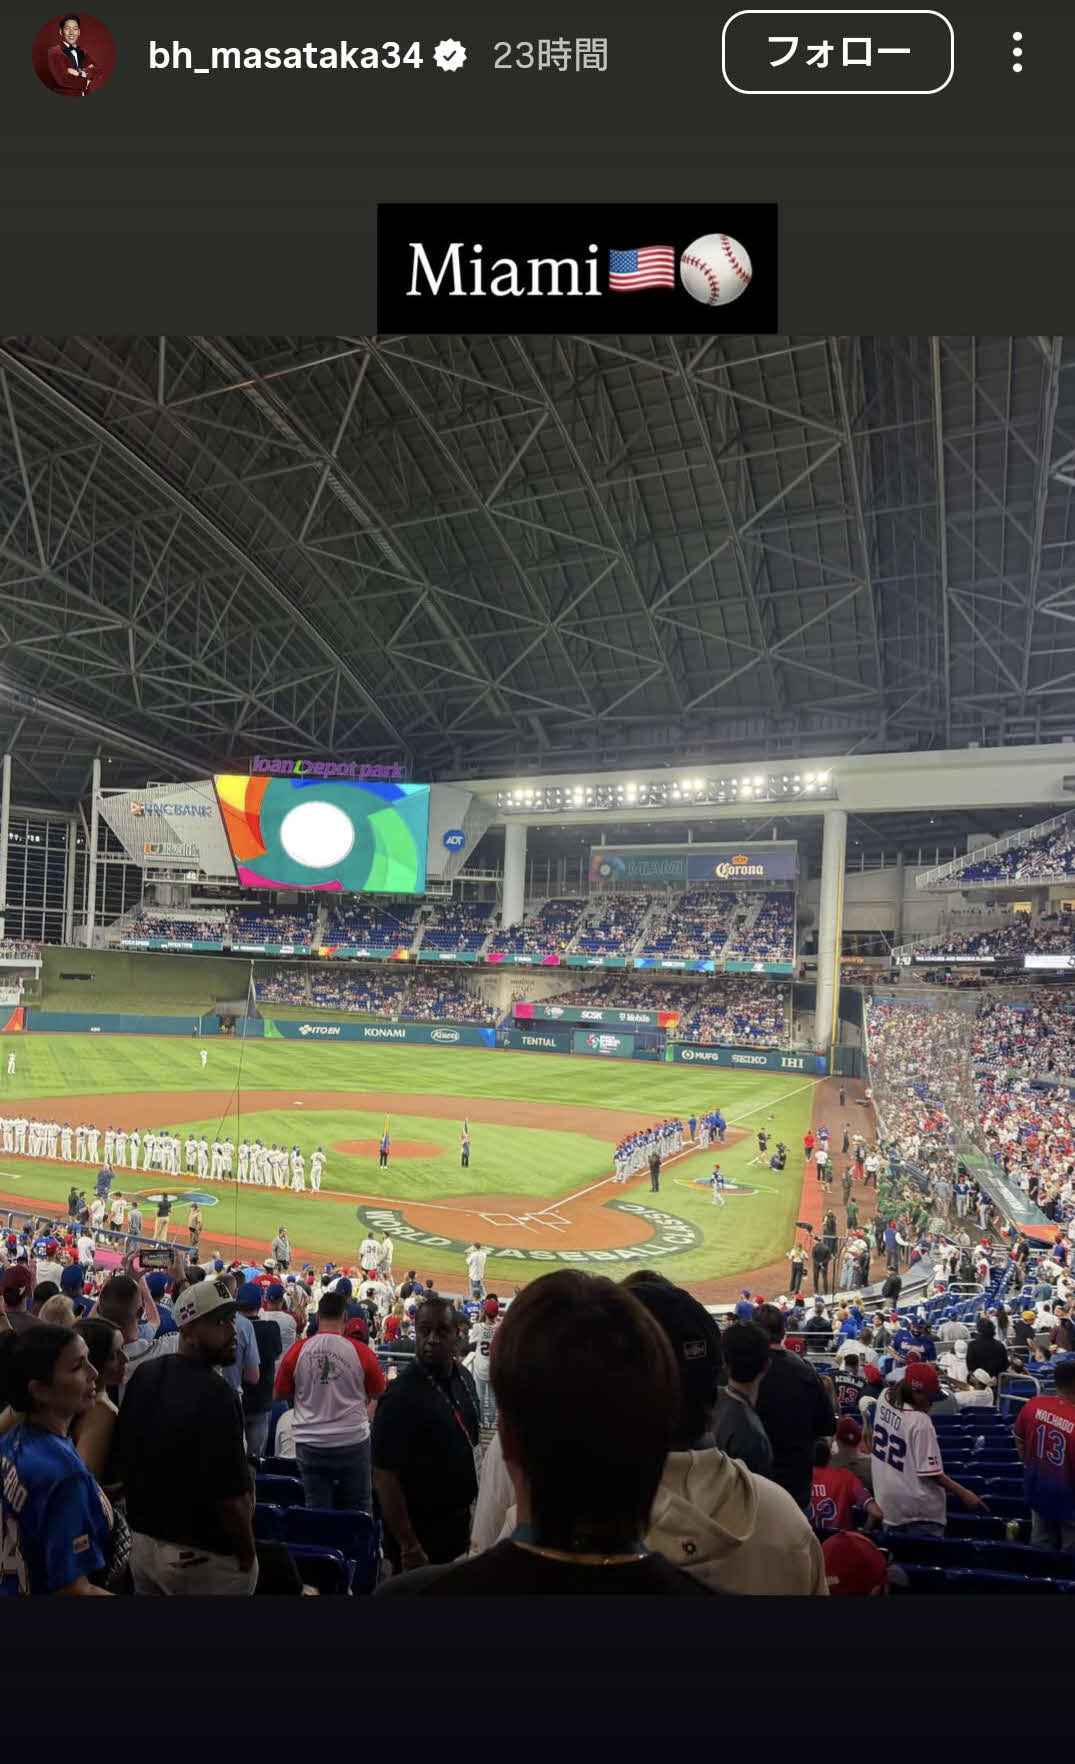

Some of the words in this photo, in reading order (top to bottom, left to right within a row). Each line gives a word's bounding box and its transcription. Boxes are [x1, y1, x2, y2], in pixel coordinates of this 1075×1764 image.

[446, 836, 464, 845] ADT
[716, 862, 764, 879] Corona
[364, 1028, 406, 1038] KONAMI
[522, 1036, 557, 1047] TENTIAL
[695, 1053, 719, 1061] MUFG
[731, 1054, 767, 1064] SEIKO
[781, 1057, 804, 1069] IHI
[365, 1210, 452, 1246] WORLD
[618, 1204, 696, 1244] CLASSIC
[880, 1406, 902, 1431] SOTO
[1035, 1408, 1074, 1434] MACHADO
[872, 1424, 907, 1472] 22
[1037, 1424, 1066, 1466] 13
